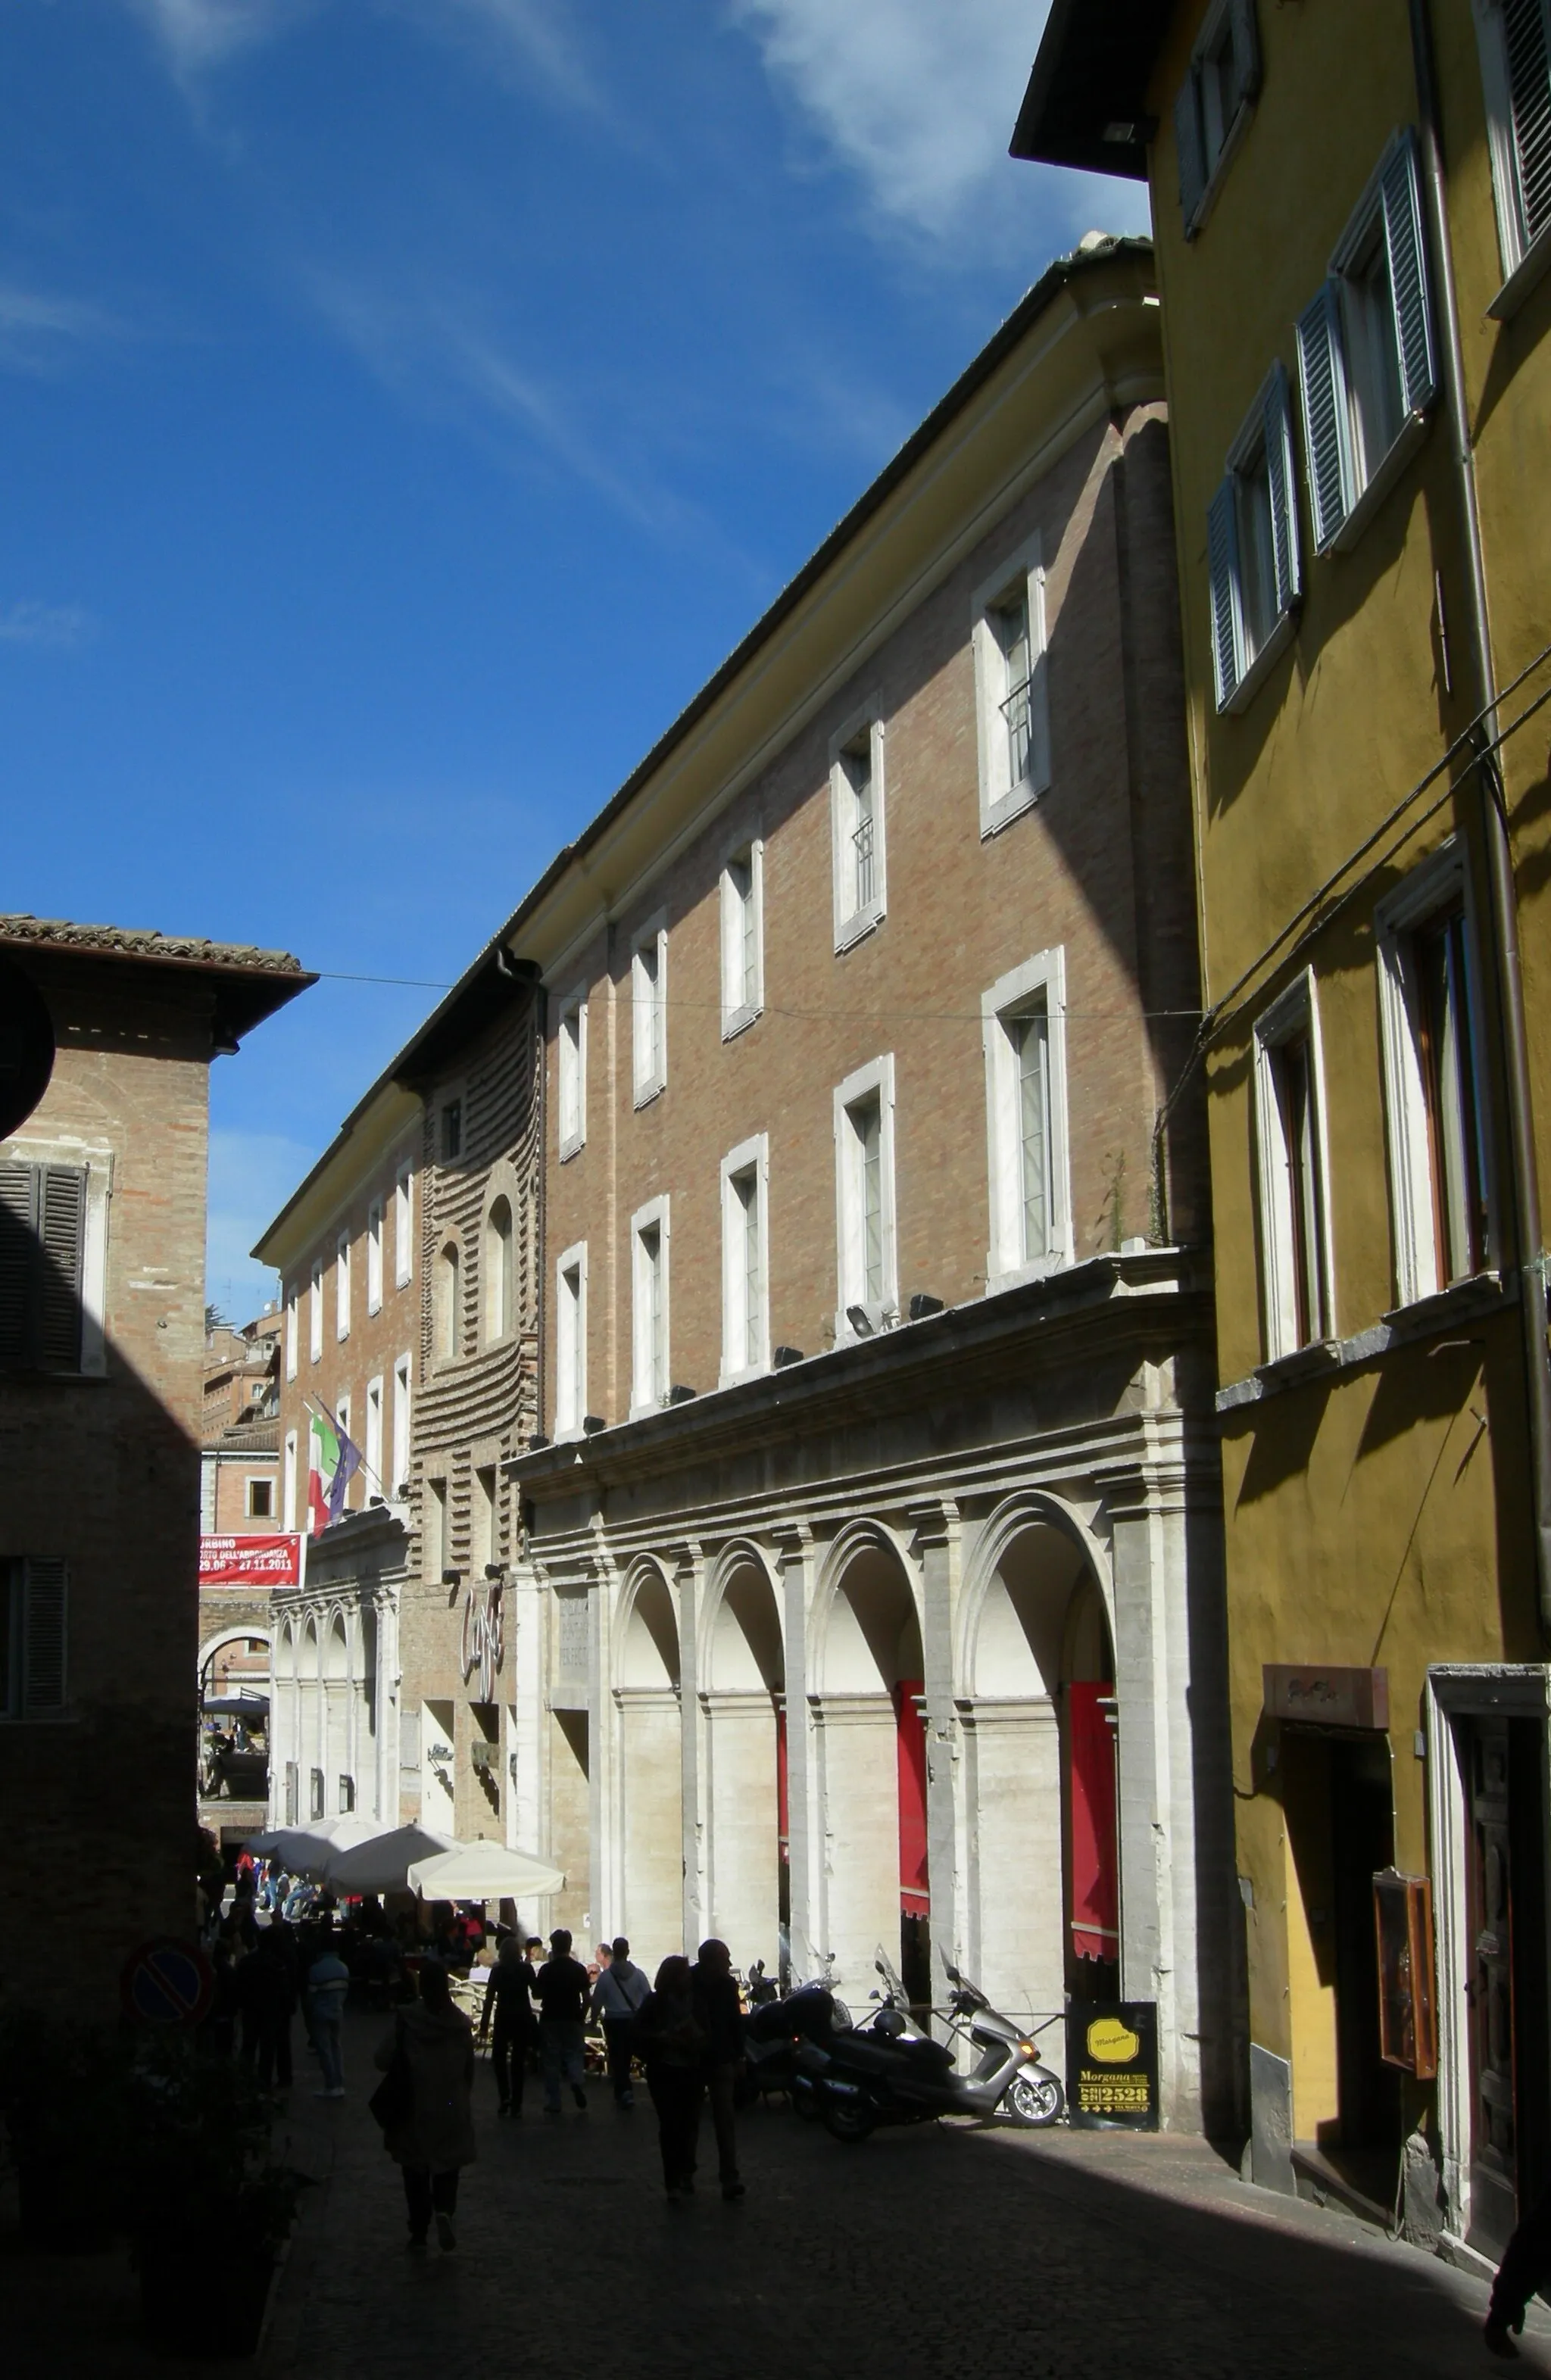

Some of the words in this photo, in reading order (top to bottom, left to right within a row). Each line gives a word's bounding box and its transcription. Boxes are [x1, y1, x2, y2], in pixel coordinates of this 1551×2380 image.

[239, 1559, 292, 1571] 27.11.2011
[1094, 2034, 1130, 2047] Morgana
[1080, 2070, 1131, 2083] Morgana
[1102, 2087, 1147, 2101] 2528
